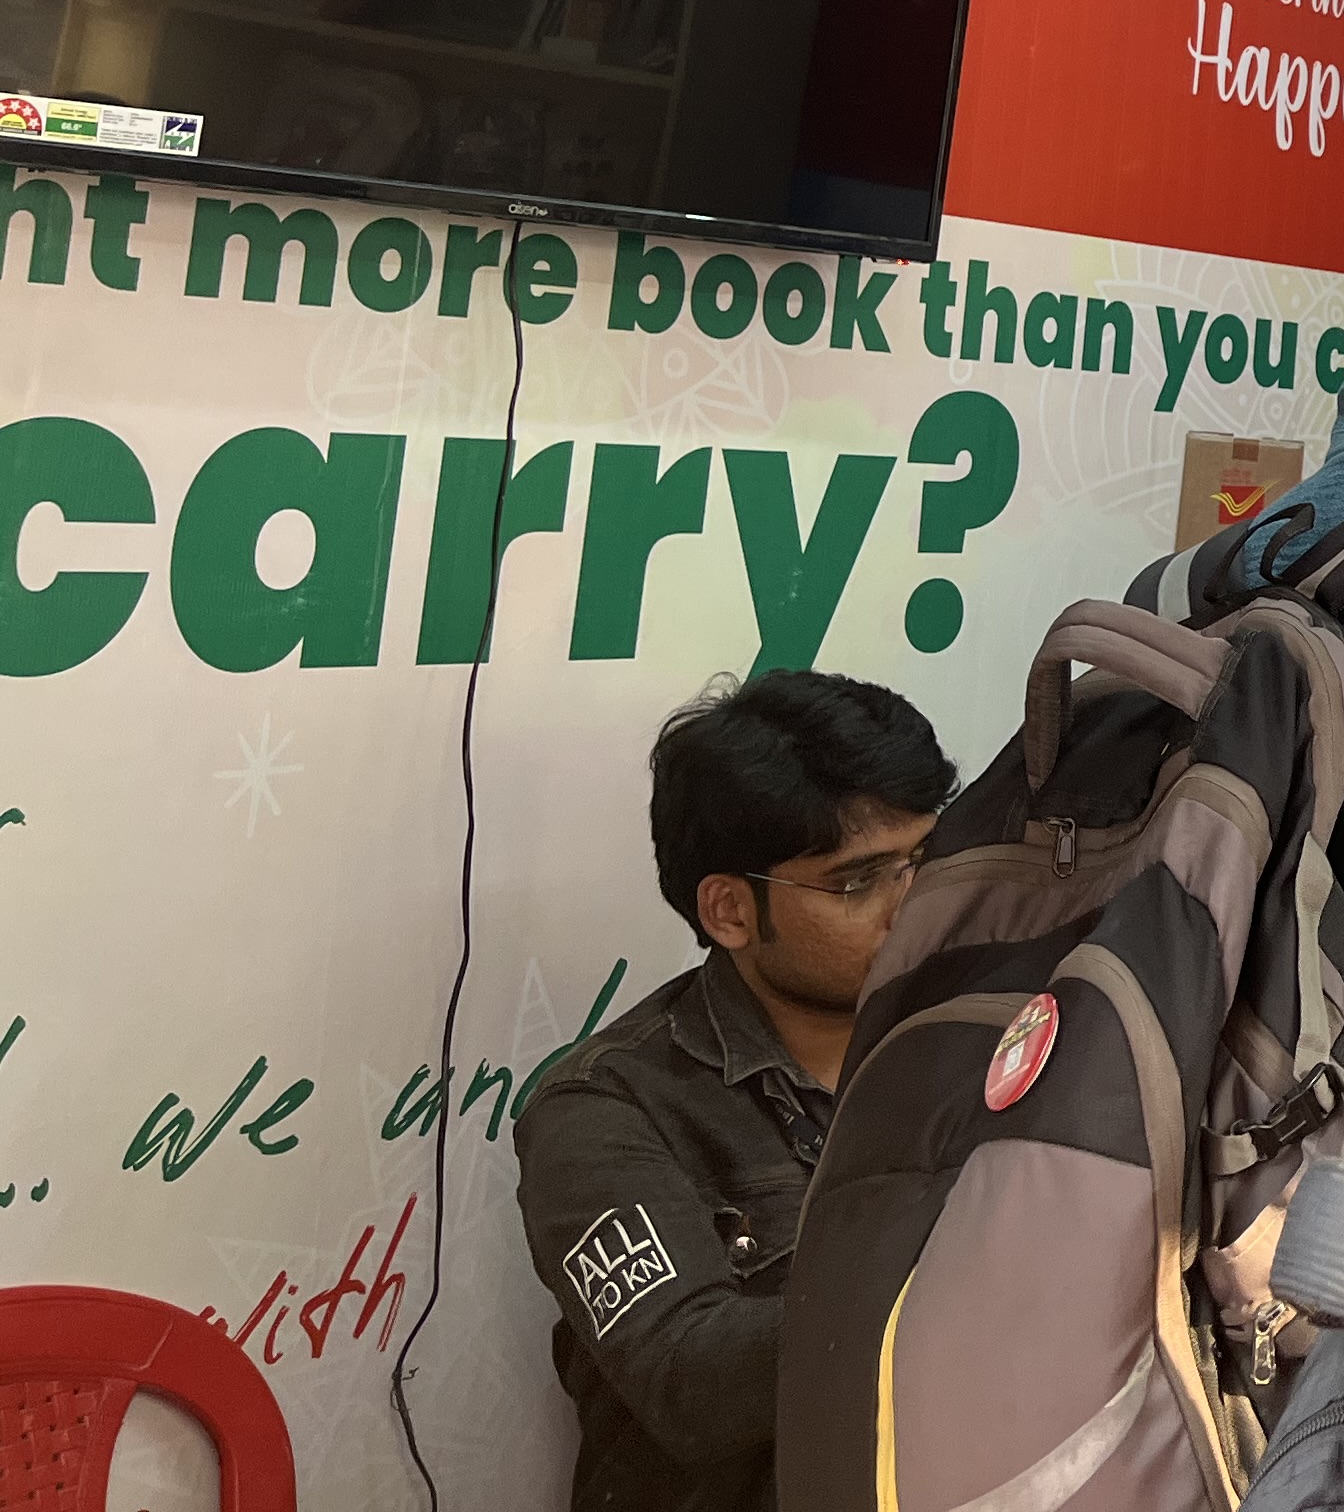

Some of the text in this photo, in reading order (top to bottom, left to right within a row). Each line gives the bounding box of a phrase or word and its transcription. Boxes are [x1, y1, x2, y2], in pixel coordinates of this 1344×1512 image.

[184, 197, 579, 325] more
[607, 226, 898, 354] book
[919, 258, 1135, 376] than
[1153, 305, 1300, 413] you
[0, 391, 1020, 678] carry?
[122, 1054, 315, 1183] we
[577, 1218, 652, 1299] ALL
[592, 1250, 664, 1320] TO KN
